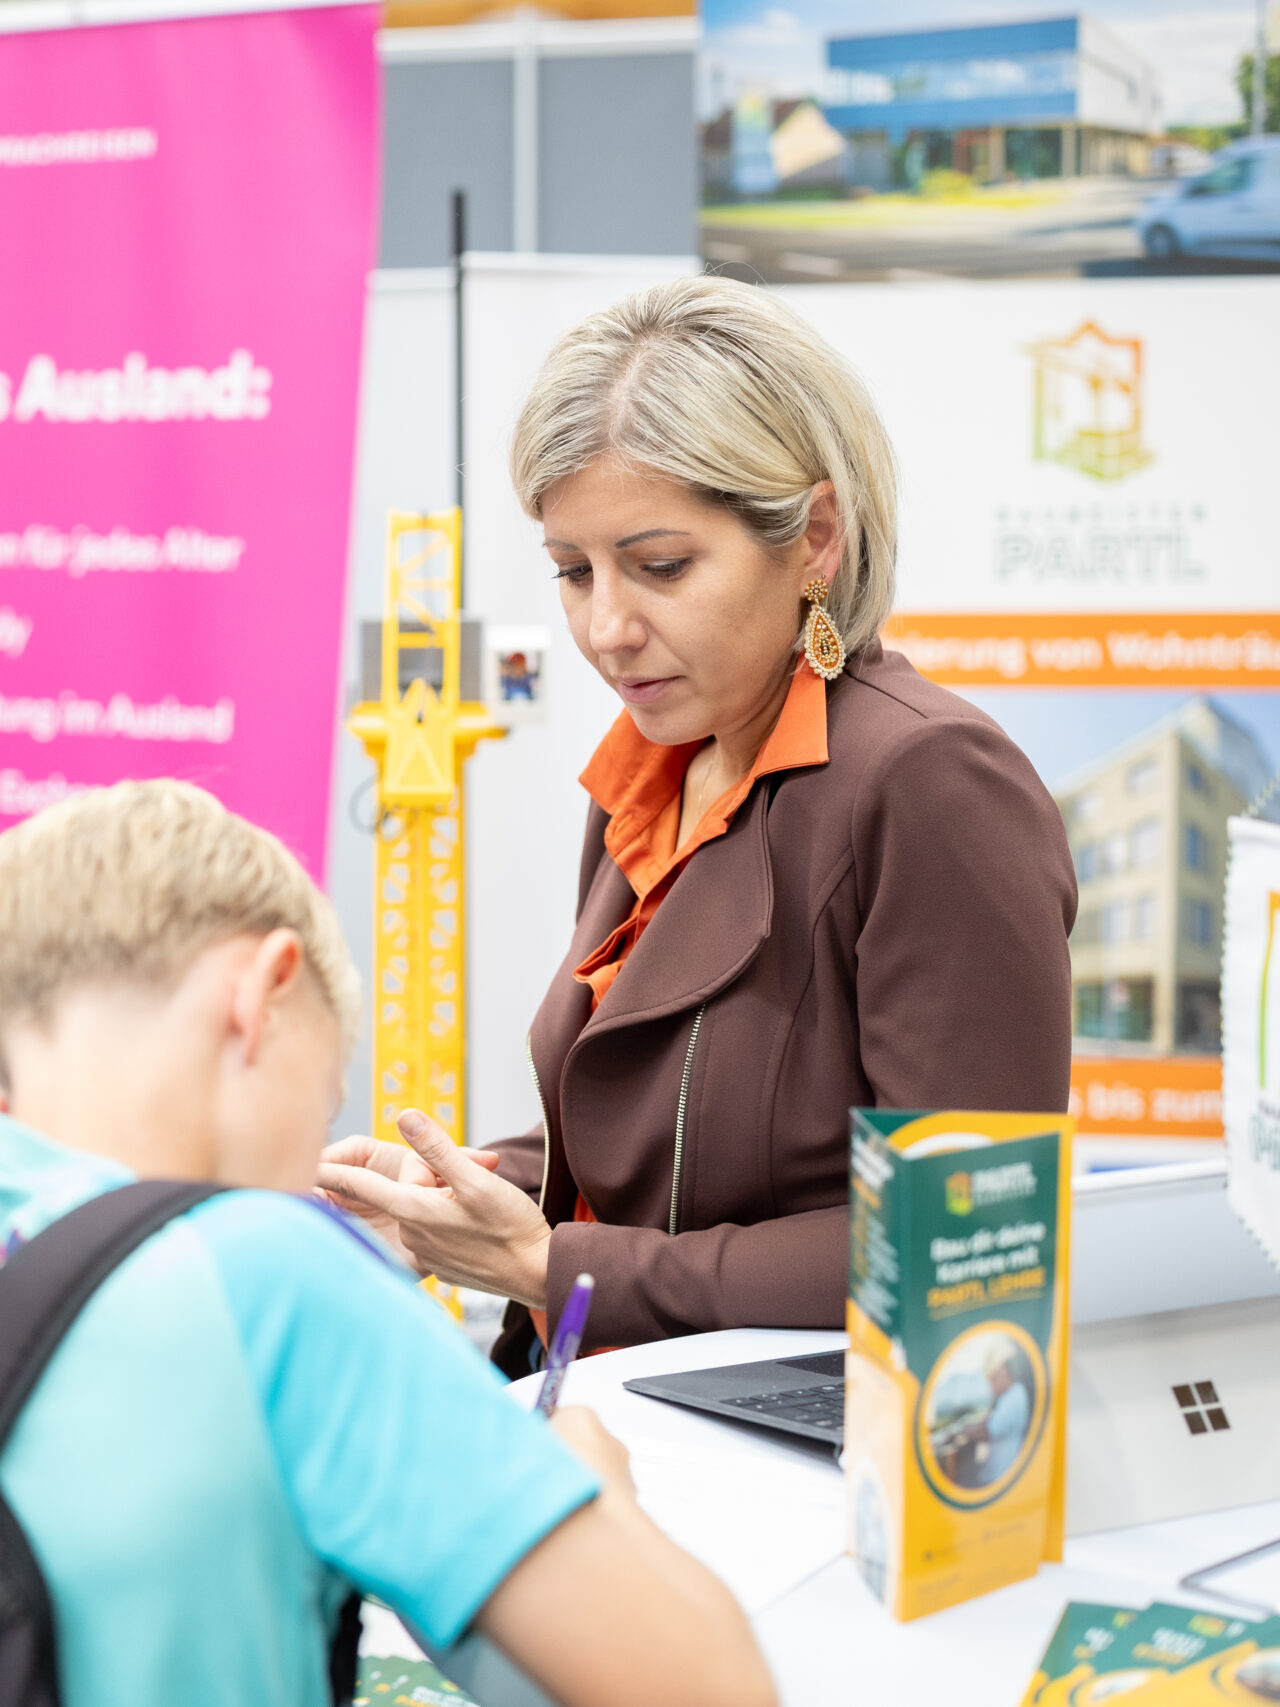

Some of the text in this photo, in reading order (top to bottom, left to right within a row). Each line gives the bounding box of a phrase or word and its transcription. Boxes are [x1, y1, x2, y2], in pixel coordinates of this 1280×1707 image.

[16, 350, 272, 423] Ausland:
[24, 524, 67, 569] für
[69, 525, 160, 576] jedes
[166, 526, 246, 572] Alter
